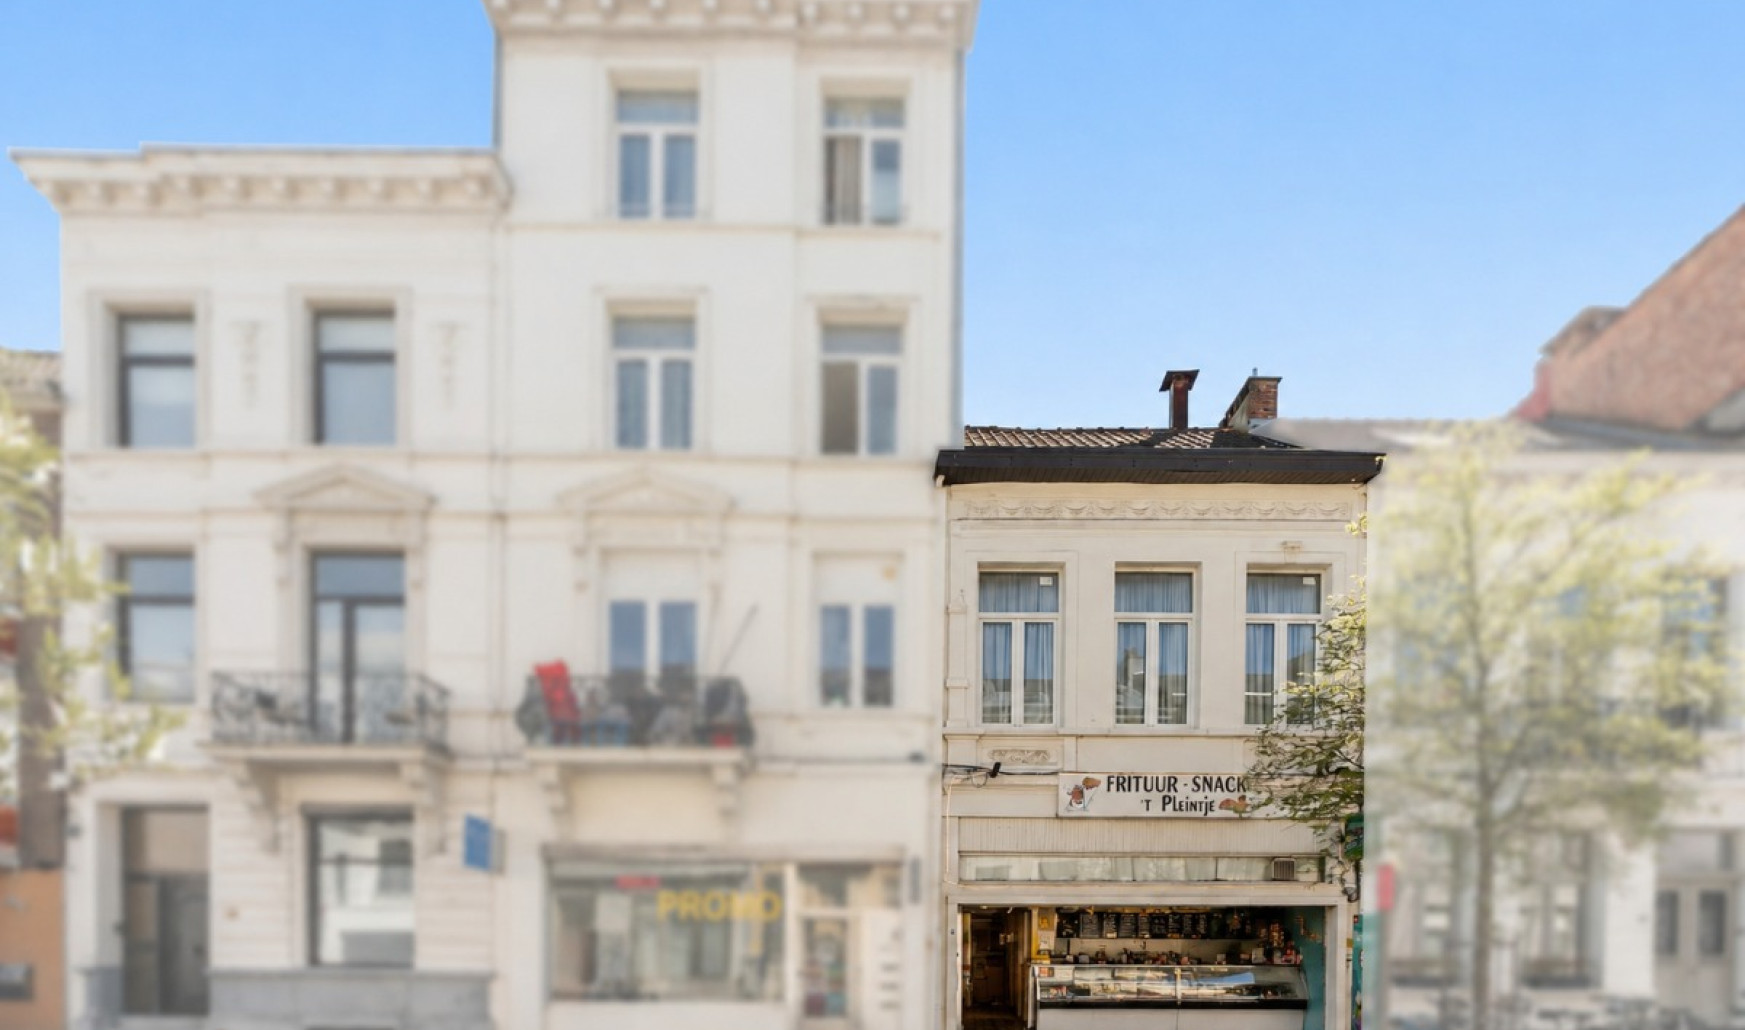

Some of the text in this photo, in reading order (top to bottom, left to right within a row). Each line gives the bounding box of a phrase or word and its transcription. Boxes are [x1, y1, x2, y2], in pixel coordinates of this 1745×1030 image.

[1106, 775, 1179, 793] FRITUUR
[1191, 775, 1247, 793] SNACK
[656, 889, 782, 922] PROMO
